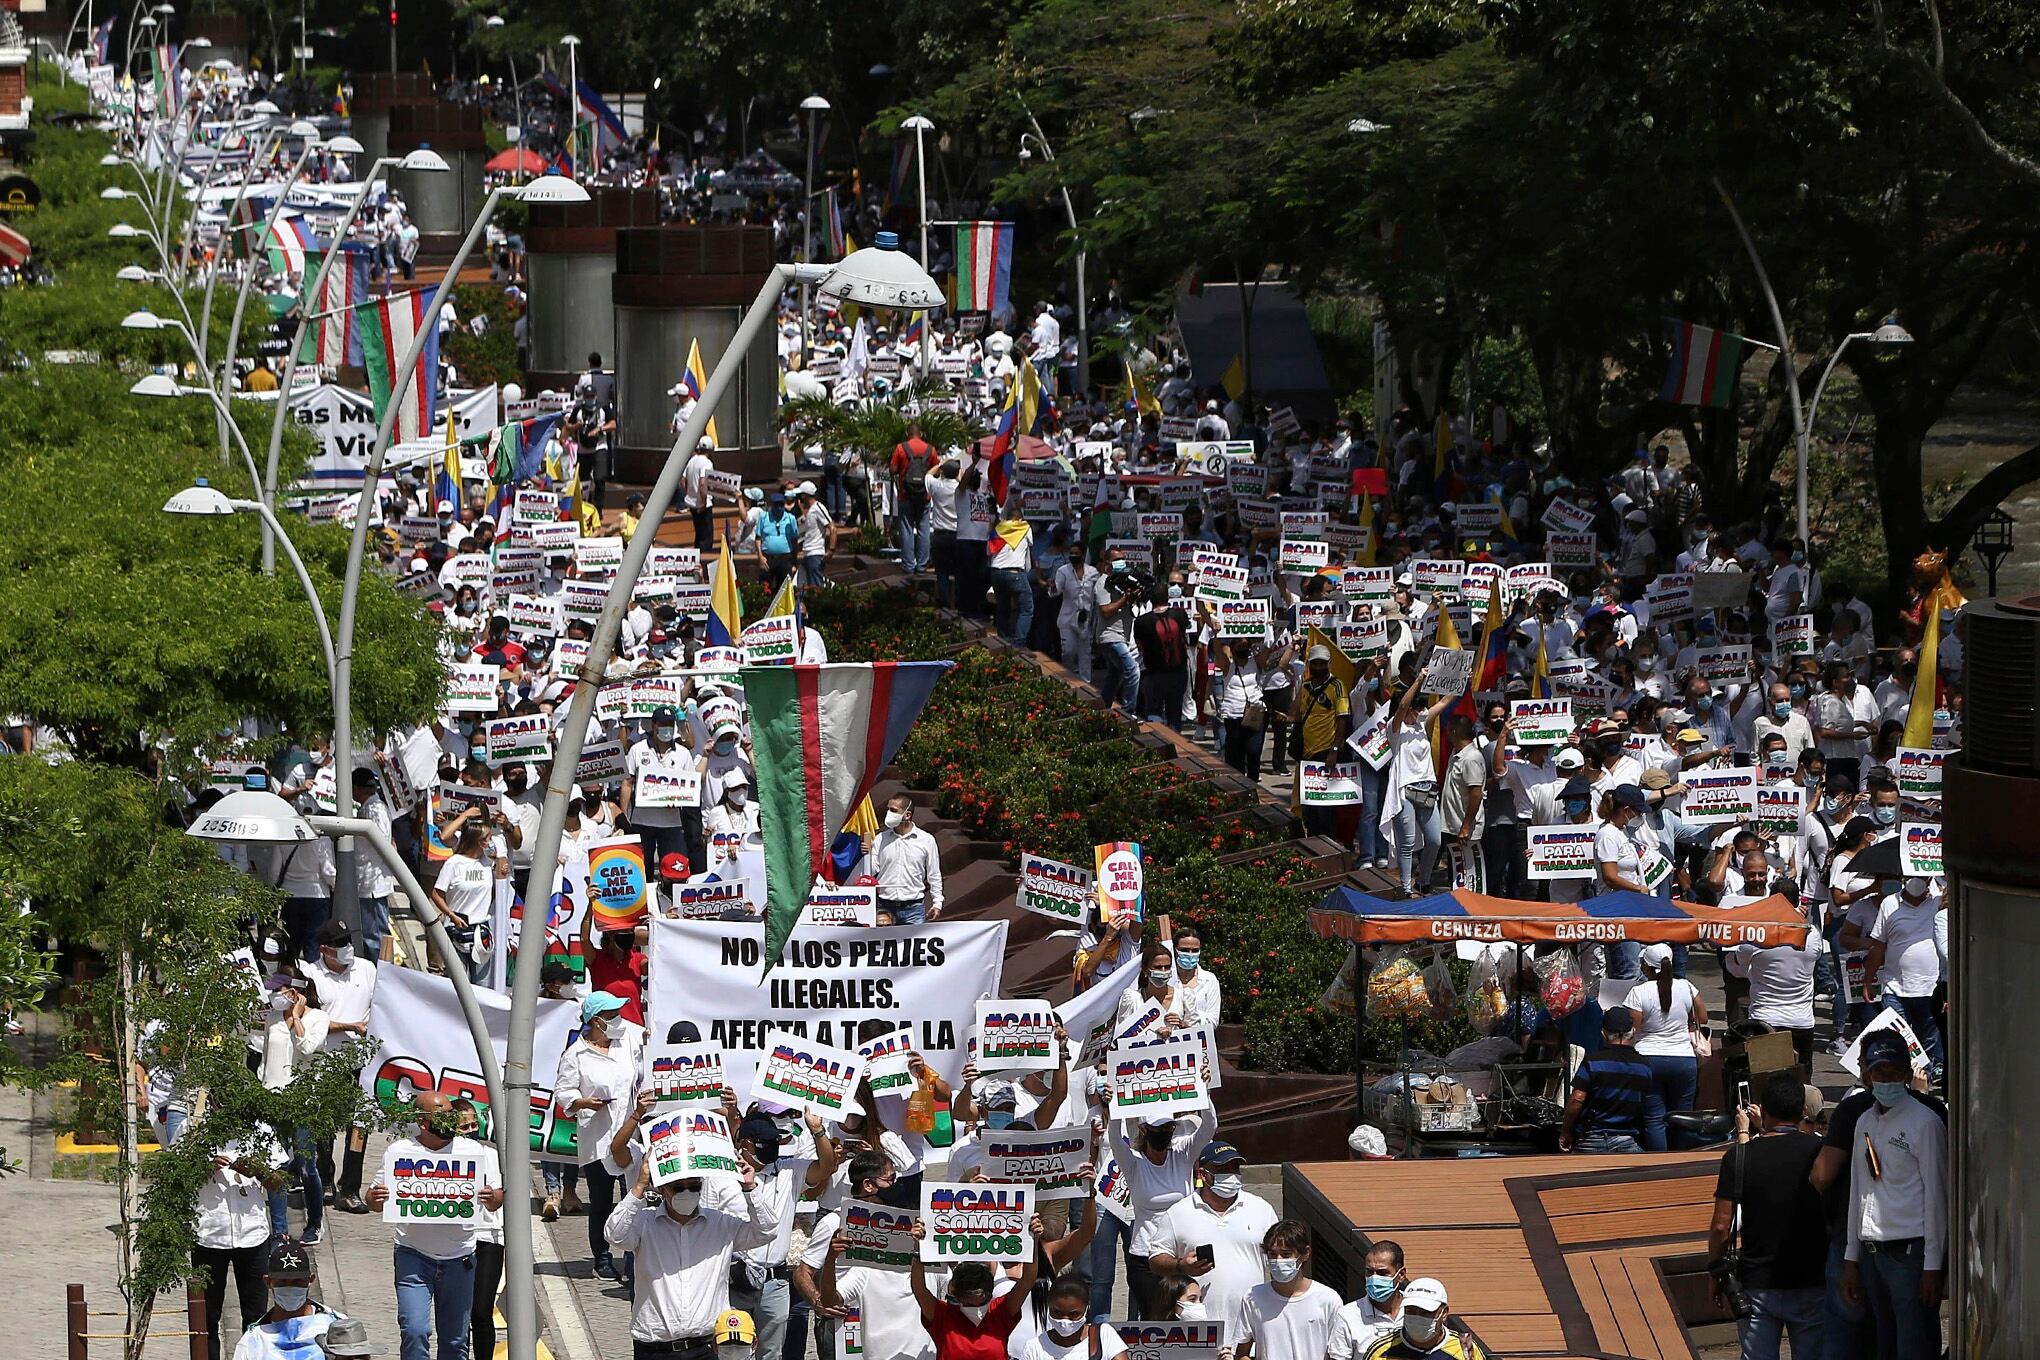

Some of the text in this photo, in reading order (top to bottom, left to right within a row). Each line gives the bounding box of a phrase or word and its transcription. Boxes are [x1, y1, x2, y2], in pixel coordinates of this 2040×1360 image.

[290, 403, 331, 423] ás
[1283, 543, 1326, 557] #CALI
[655, 555, 696, 564] #CALI
[1202, 565, 1246, 583] #CALI
[1344, 570, 1390, 583] #CALI
[1415, 563, 1462, 577] #CALI
[492, 575, 535, 591] #CALI
[511, 600, 555, 616] #CALI
[1223, 602, 1265, 616] #CALI
[1299, 604, 1345, 619] #CALI
[1223, 613, 1265, 625] SOMOS
[745, 619, 791, 637] #CALI
[1223, 625, 1266, 638] TODOS
[1340, 620, 1386, 640] #CALI
[745, 633, 793, 648] SOMOS
[746, 642, 794, 658] TODOS
[631, 680, 677, 692] #CALI
[631, 692, 677, 705] SOMOS
[1515, 701, 1568, 718] #CALI
[490, 717, 548, 738] #CALI
[1519, 728, 1569, 742] NECESITA
[491, 736, 517, 749] NOS
[643, 773, 697, 788] #CALI
[1304, 781, 1328, 795] NOS
[1304, 791, 1360, 801] NECESITA
[1697, 788, 1740, 803] PARA
[1686, 803, 1753, 817] TRABAJAR
[1544, 845, 1586, 858] PARA
[465, 870, 485, 881] NIKE
[607, 878, 628, 888] ME
[1026, 861, 1087, 889] #CALI
[1114, 872, 1135, 882] ME
[598, 886, 636, 898] AMA
[681, 884, 744, 907] #CALI
[1024, 877, 1086, 904] SOMOS
[1109, 881, 1139, 893] AMA
[1025, 890, 1082, 918] TODOS
[813, 907, 857, 920] PARA
[1431, 920, 1767, 944] CERVEZA GASEOSA VIVE 100
[722, 937, 759, 966] NO
[792, 938, 841, 968] LOS
[849, 937, 945, 967] PEAJES
[771, 979, 899, 1009] ILEGALES.
[984, 1013, 1053, 1037] #CALI
[924, 1020, 955, 1050] LA
[983, 1033, 1051, 1058] LIBRE
[653, 1053, 722, 1084] #CALI
[772, 1044, 855, 1091] #CALI
[1116, 1053, 1197, 1083] #CALI
[653, 1077, 722, 1101] LIBRE
[763, 1067, 844, 1109] LIBRE
[1117, 1079, 1199, 1106] LIBRE
[394, 1158, 476, 1182] #CALI
[1005, 1156, 1065, 1177] PARA
[395, 1181, 475, 1200] SOMOS
[395, 1199, 475, 1219] TODOS
[931, 1188, 1024, 1213] #CALI
[934, 1214, 1023, 1234] SOMOS
[847, 1231, 888, 1250] NOS
[934, 1235, 1023, 1255] TODOS
